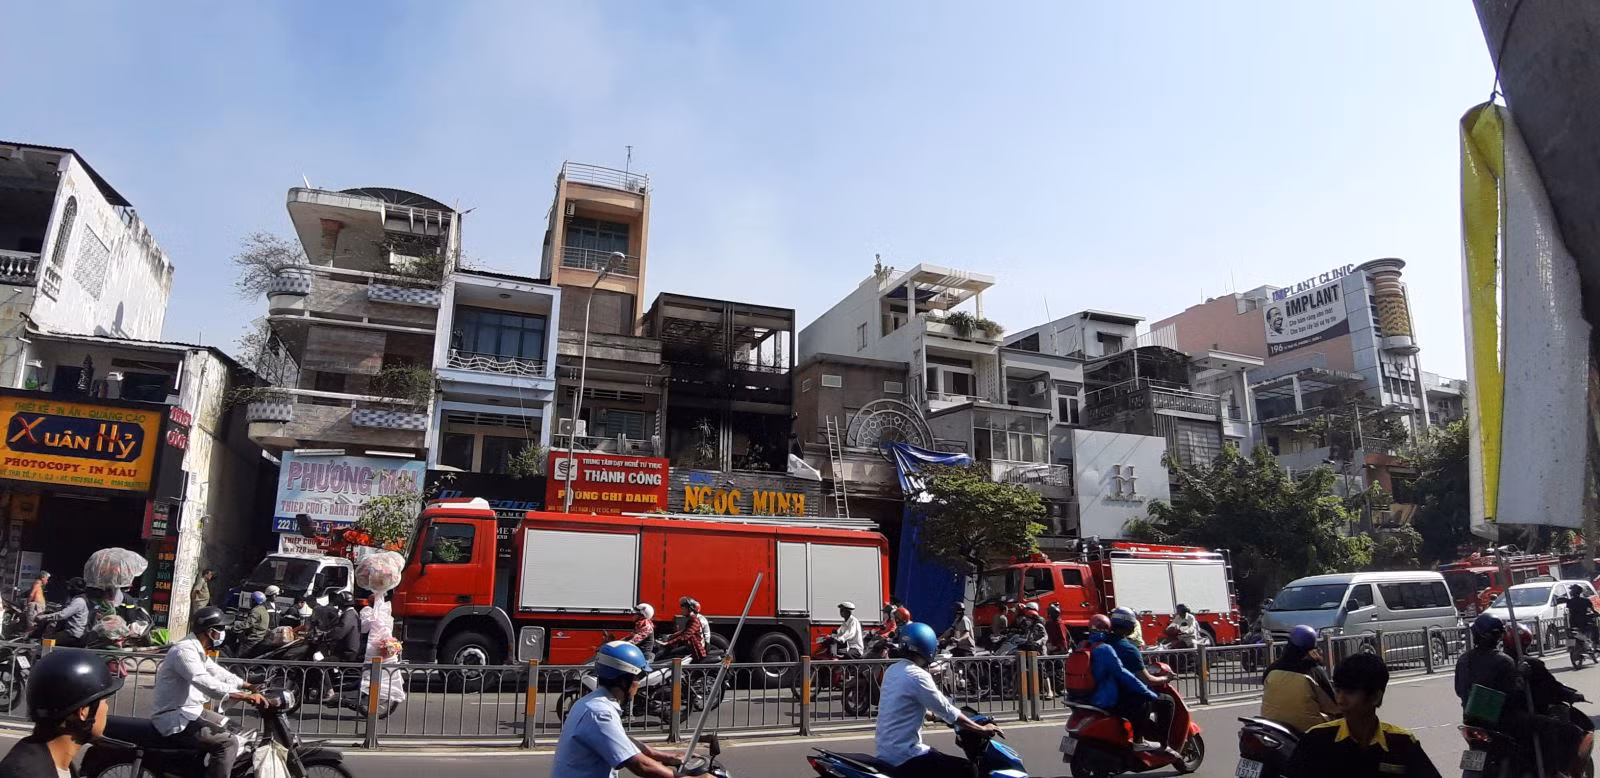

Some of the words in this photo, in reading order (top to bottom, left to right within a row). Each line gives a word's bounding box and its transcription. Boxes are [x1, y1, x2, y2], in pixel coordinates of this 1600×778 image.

[1272, 276, 1317, 302] IMPLANT
[1318, 263, 1355, 285] CLINIC
[1270, 344, 1284, 354] 196
[4, 457, 81, 472] PHOTOCOPY
[89, 466, 104, 474] IN
[107, 467, 138, 478] MÀU
[582, 458, 600, 466] TRUNG
[601, 458, 613, 466] TÂM
[624, 459, 639, 468] NGHỀ
[287, 459, 373, 496] PHƯƠNG
[583, 468, 626, 484] THÀNH
[627, 470, 662, 486] CÔNG
[557, 488, 599, 501] PÒNG
[601, 491, 622, 501] GHI
[625, 493, 658, 504] DANH
[683, 485, 742, 515] NGỌC
[752, 489, 806, 516] MINH
[277, 519, 290, 530] 222
[155, 582, 171, 591] SCAN
